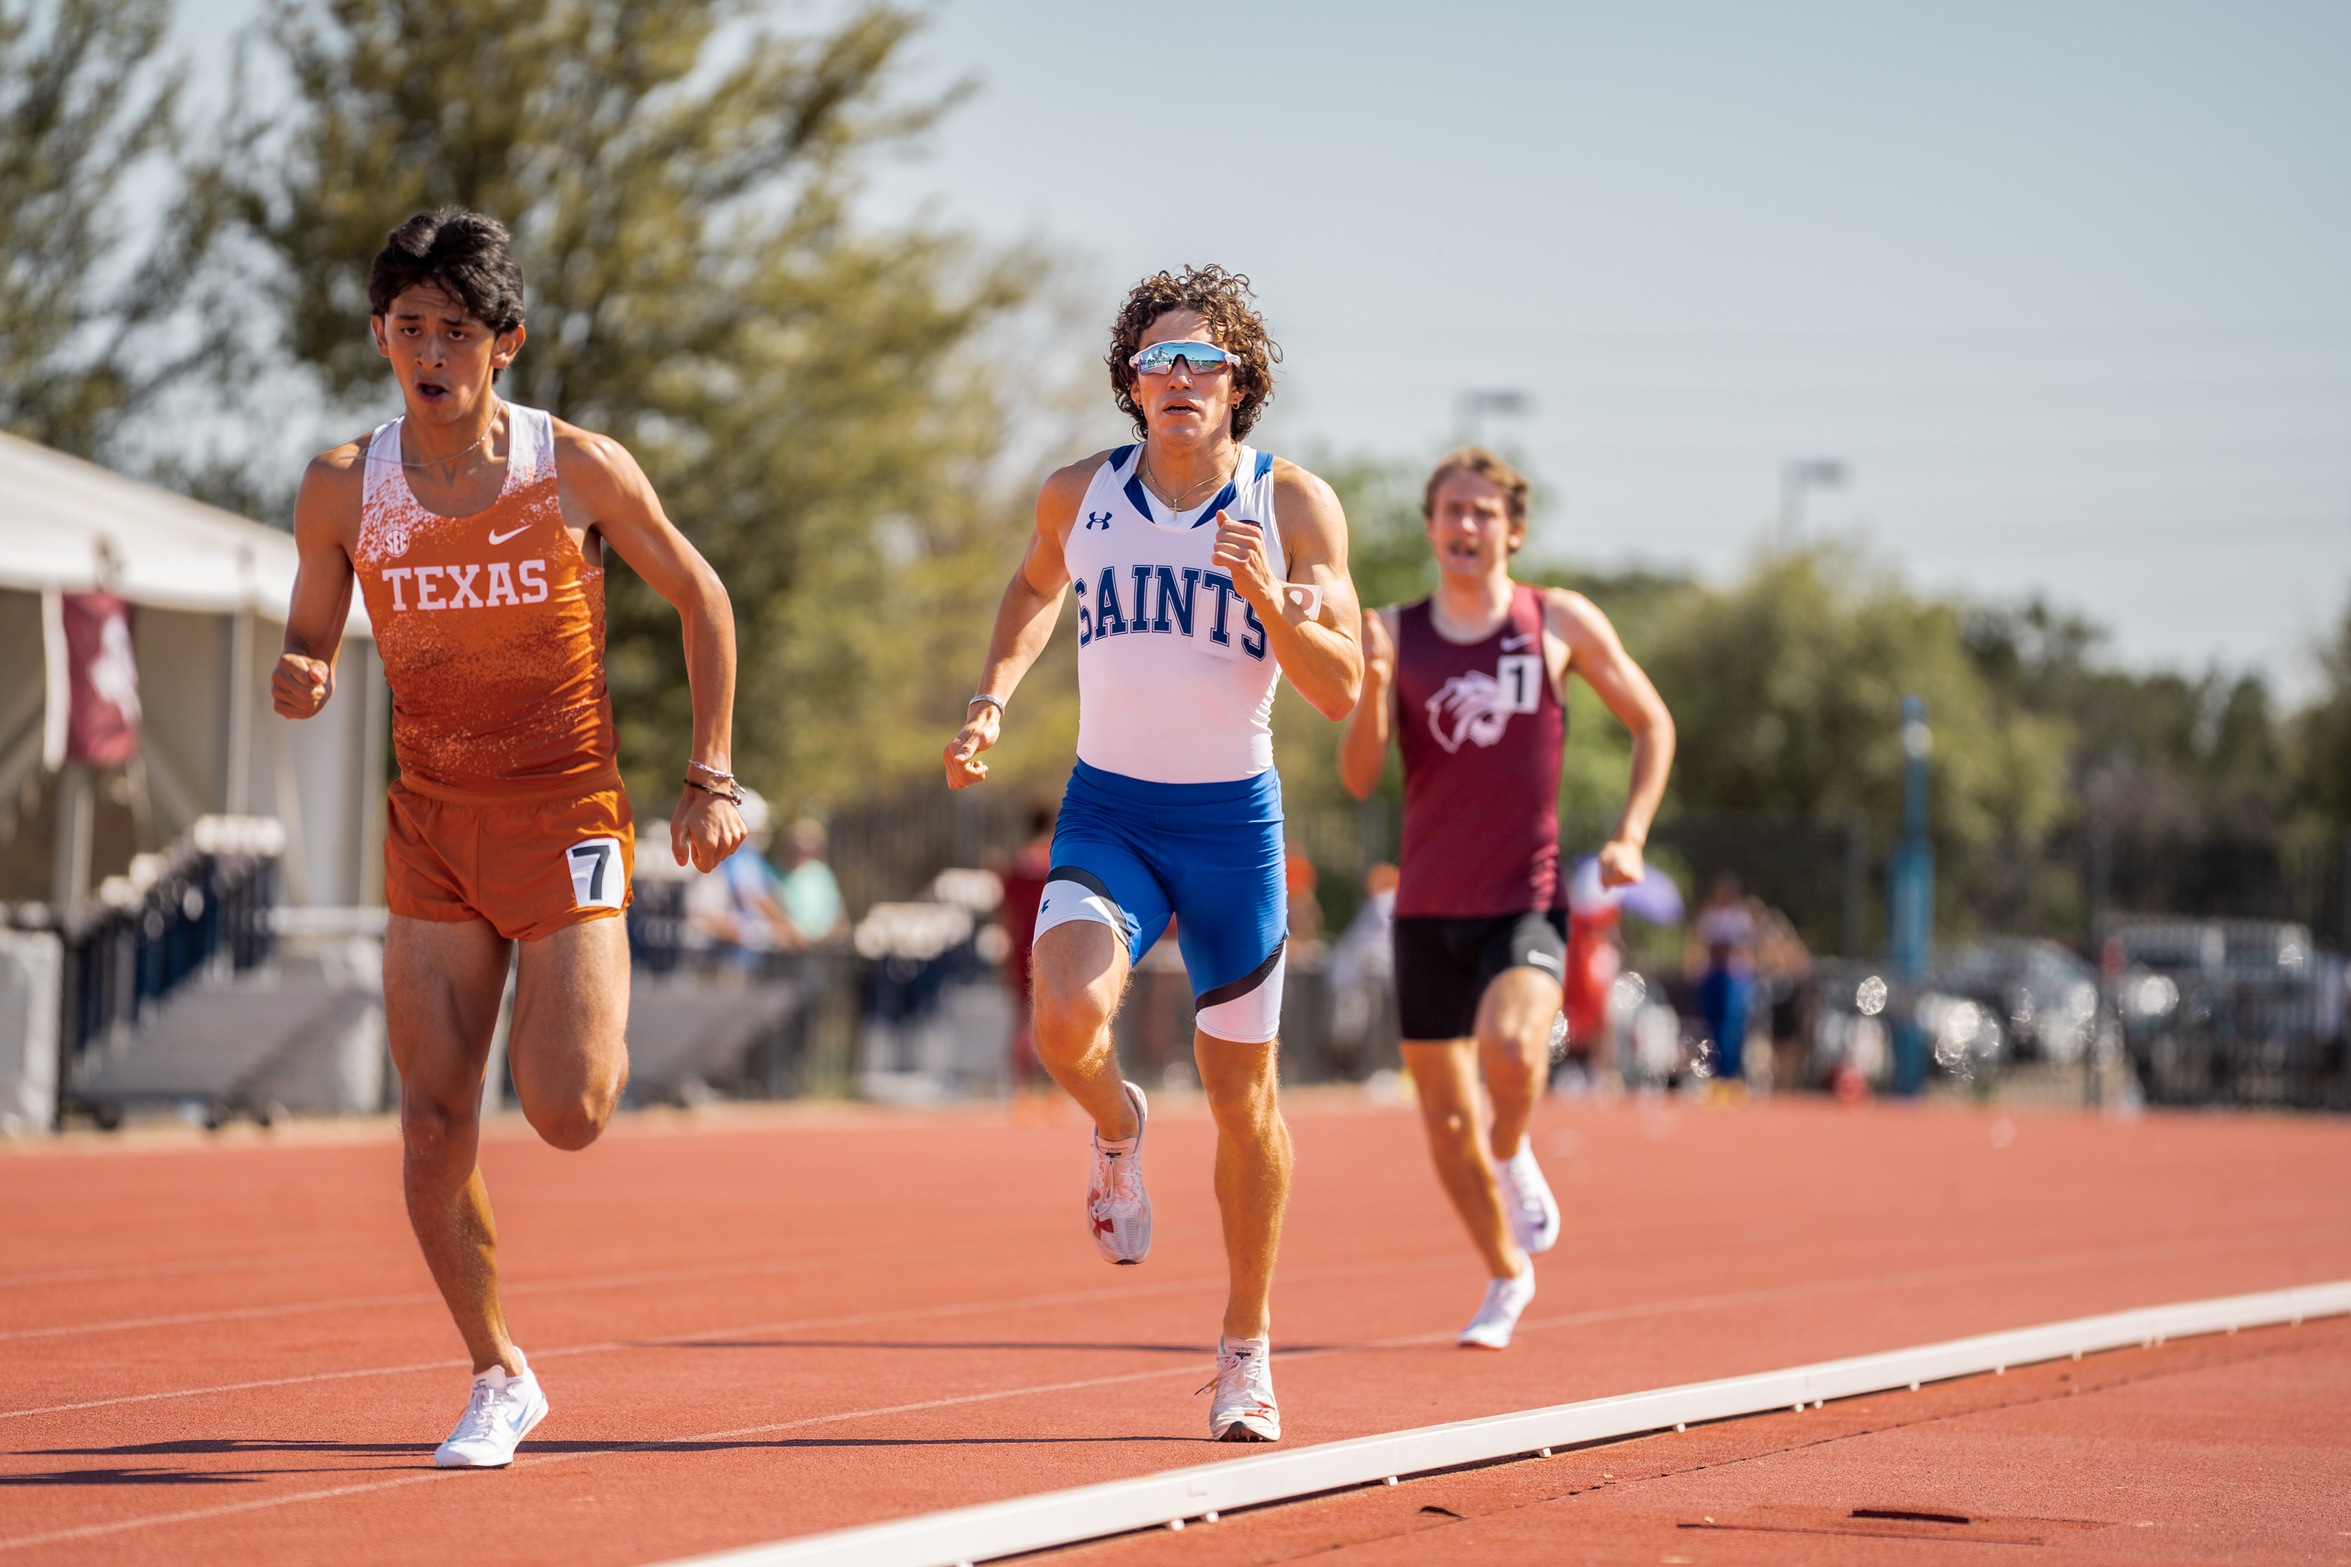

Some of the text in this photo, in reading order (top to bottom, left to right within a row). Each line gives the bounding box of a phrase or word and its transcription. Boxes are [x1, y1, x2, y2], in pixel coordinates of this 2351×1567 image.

[385, 530, 408, 555] SEC
[381, 559, 549, 611] TEXAS
[1074, 564, 1268, 662] SAINTS
[1510, 664, 1524, 704] 1
[571, 845, 610, 900] 7
